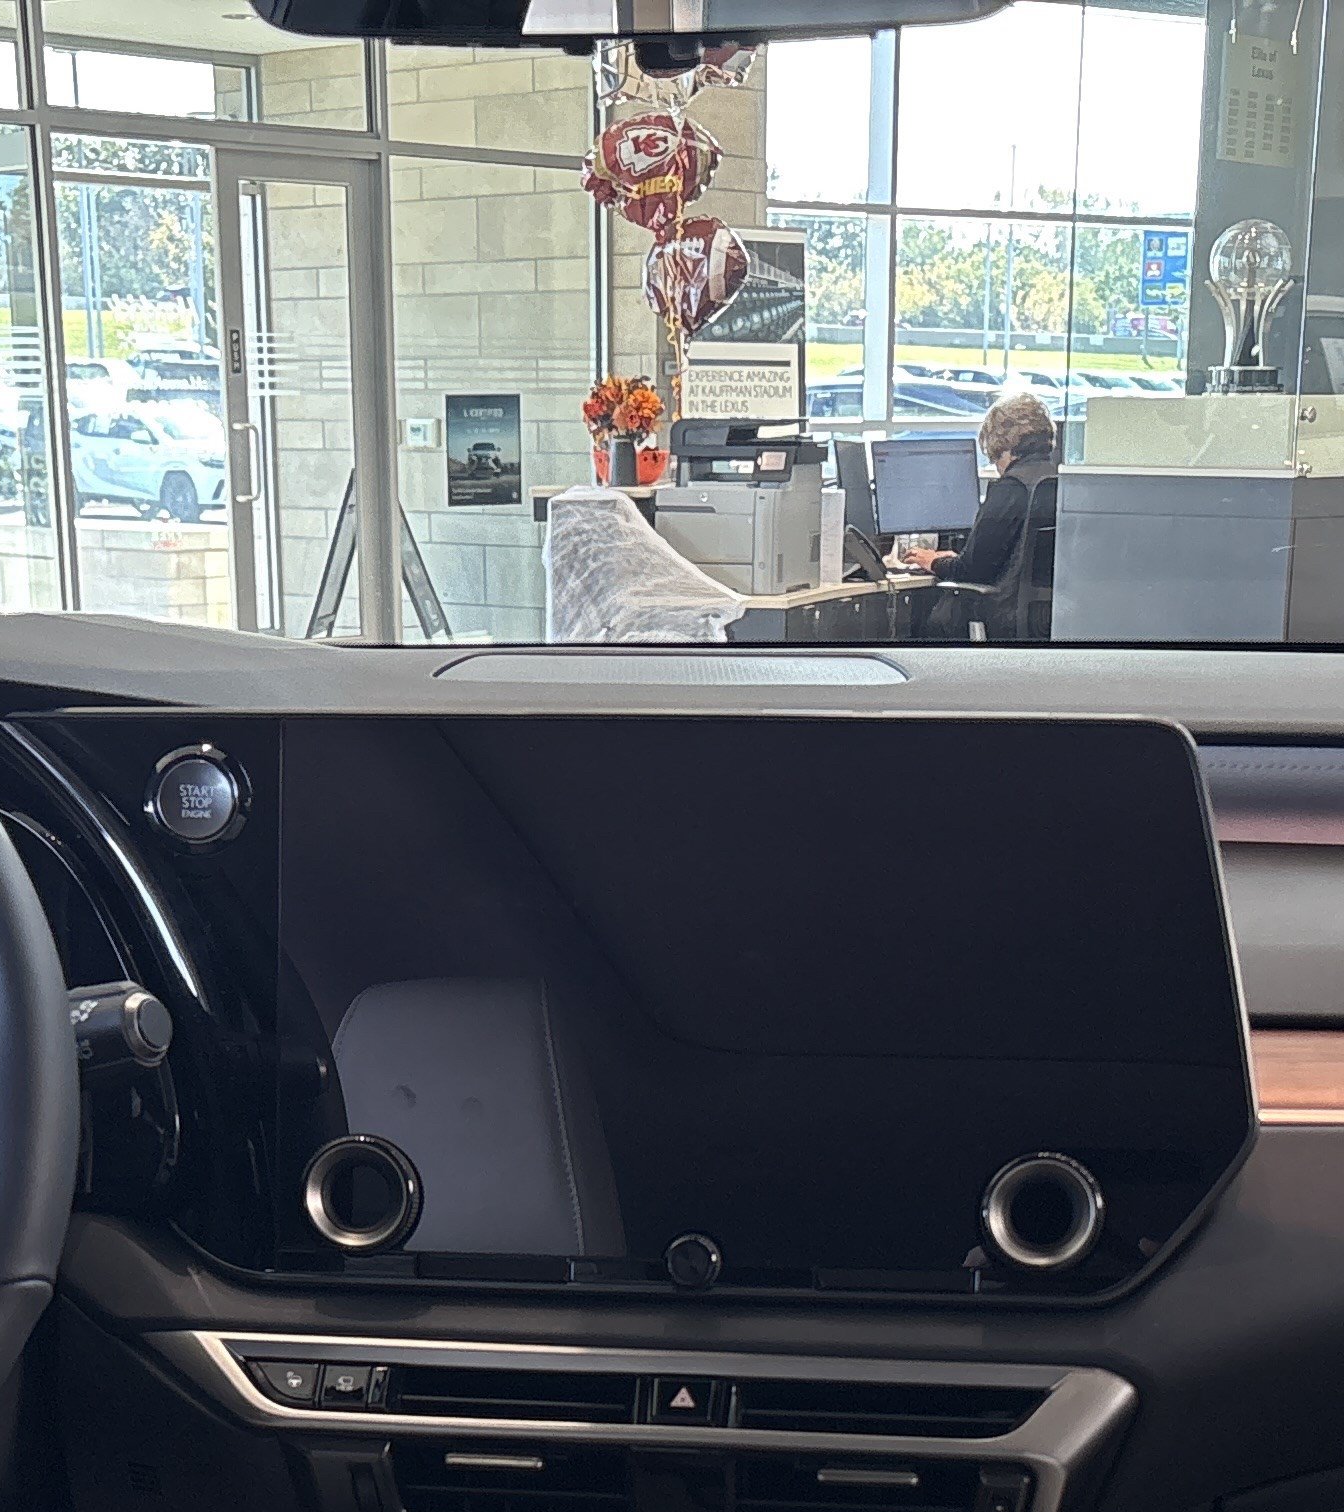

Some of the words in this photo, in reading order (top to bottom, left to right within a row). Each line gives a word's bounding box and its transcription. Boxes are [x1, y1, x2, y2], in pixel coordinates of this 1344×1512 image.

[688, 370, 744, 382] EXPERIENCE
[745, 370, 791, 383] AMAZING
[688, 384, 699, 398] AT
[701, 384, 753, 398] KAUFFMAN
[753, 385, 793, 399] STADIUM
[688, 400, 699, 413] IN
[701, 400, 717, 413] THE
[719, 400, 749, 413] LEXUS
[179, 784, 215, 797] START
[181, 797, 213, 809] STOP
